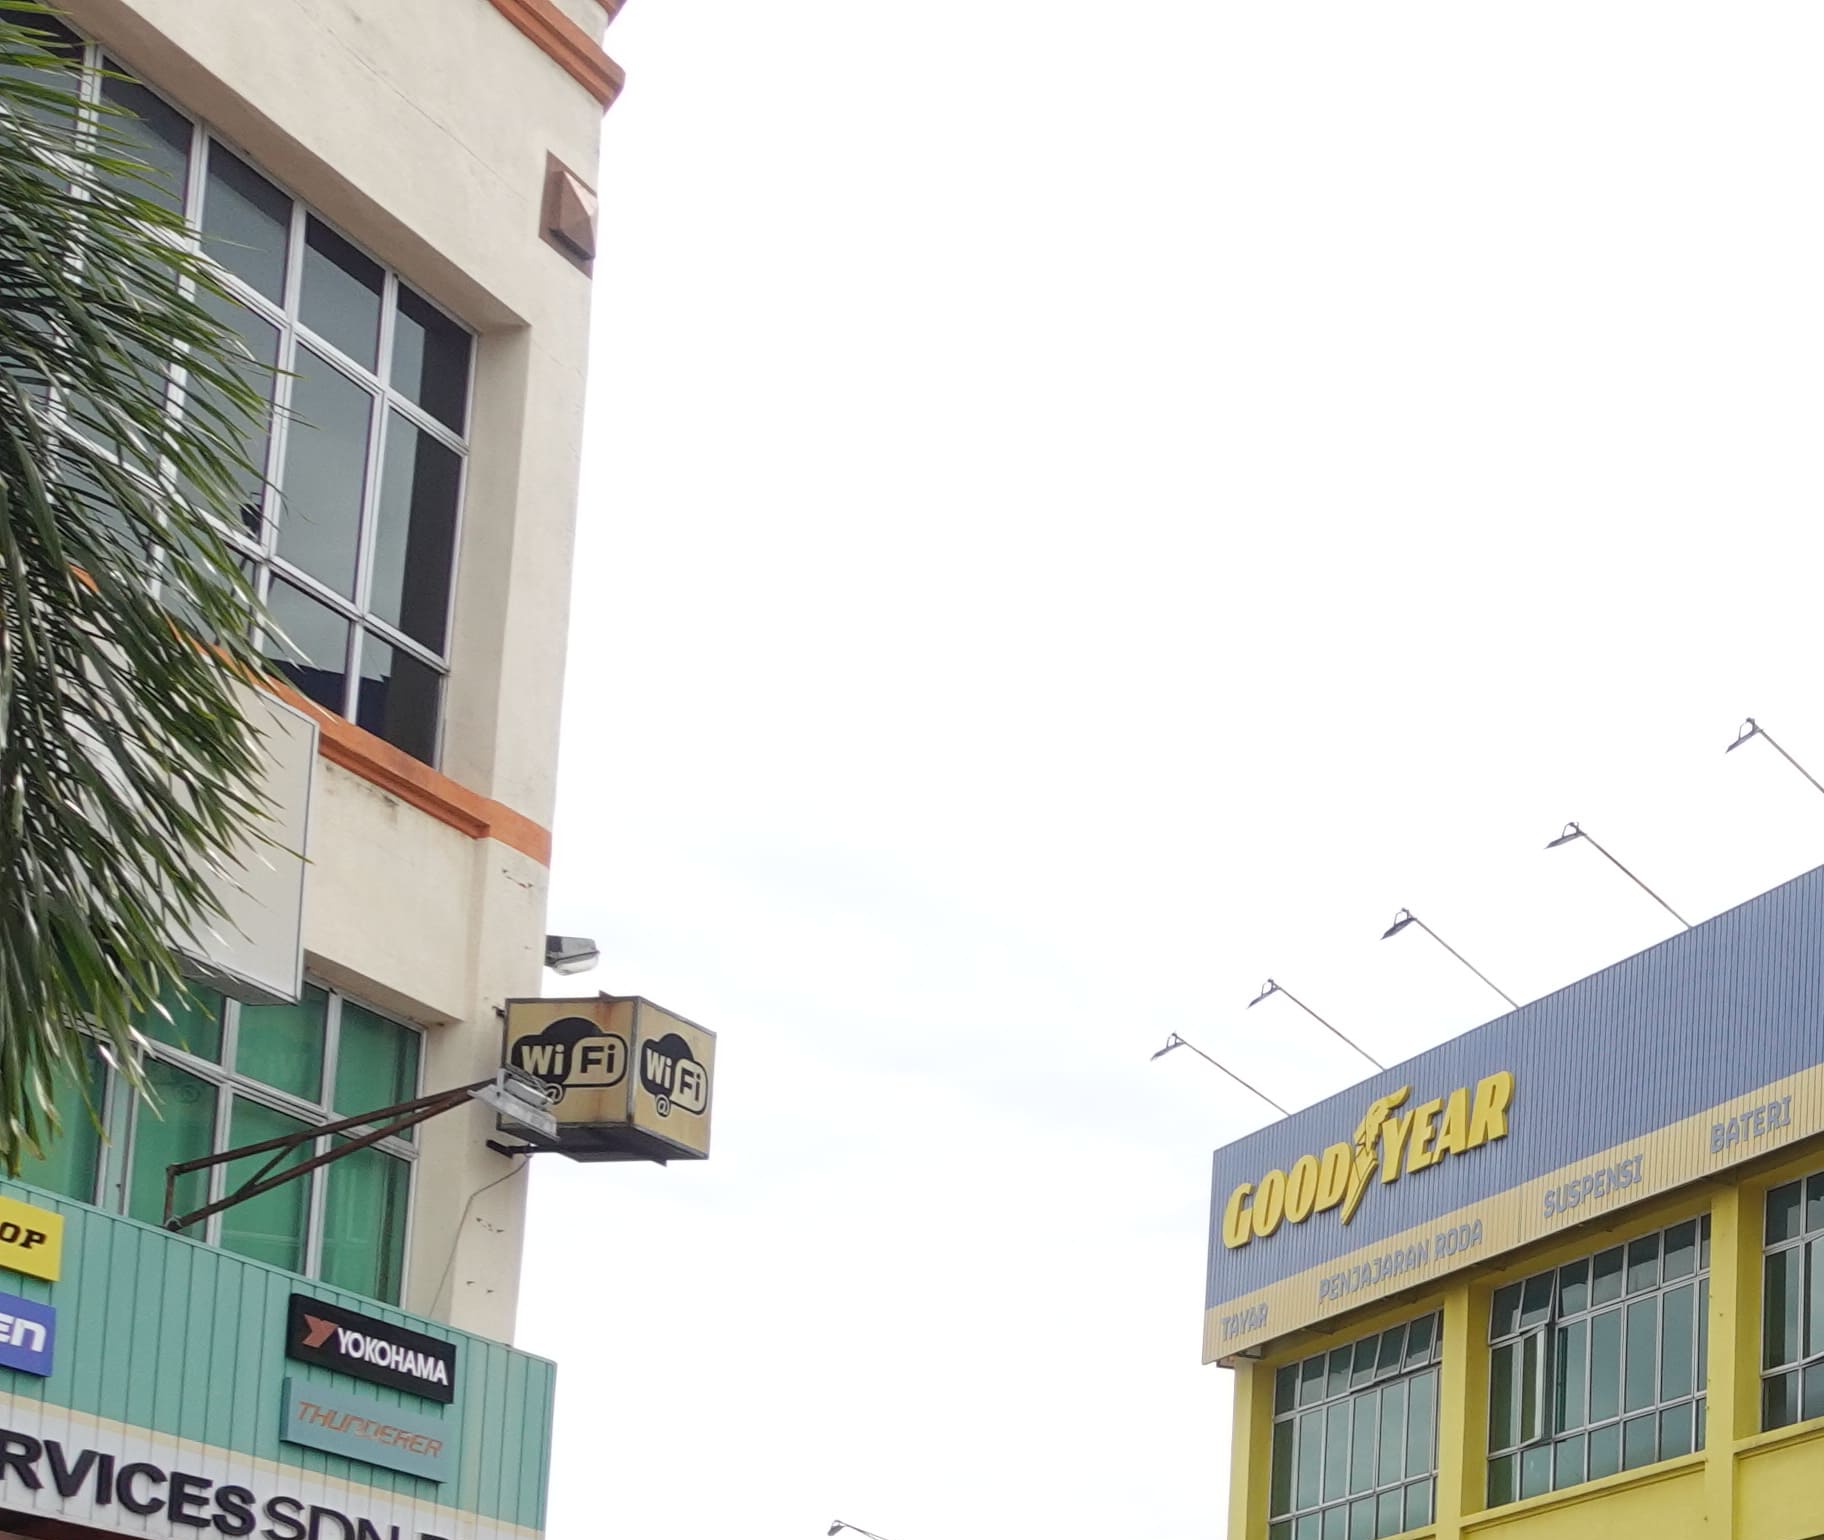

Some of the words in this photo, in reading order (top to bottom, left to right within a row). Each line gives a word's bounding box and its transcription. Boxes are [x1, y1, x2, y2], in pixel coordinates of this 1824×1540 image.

[1710, 1095, 1793, 1154] BATERI
[1222, 1070, 1515, 1250] GOODYEAR
[1542, 1154, 1645, 1219] SUSPENSI
[1318, 1241, 1430, 1305] PENJAJARAN
[1434, 1218, 1483, 1264] RODA
[1220, 1302, 1269, 1341] TAYAR
[336, 1326, 449, 1387] YOKOHAMA
[297, 1400, 445, 1458] THUNDERER
